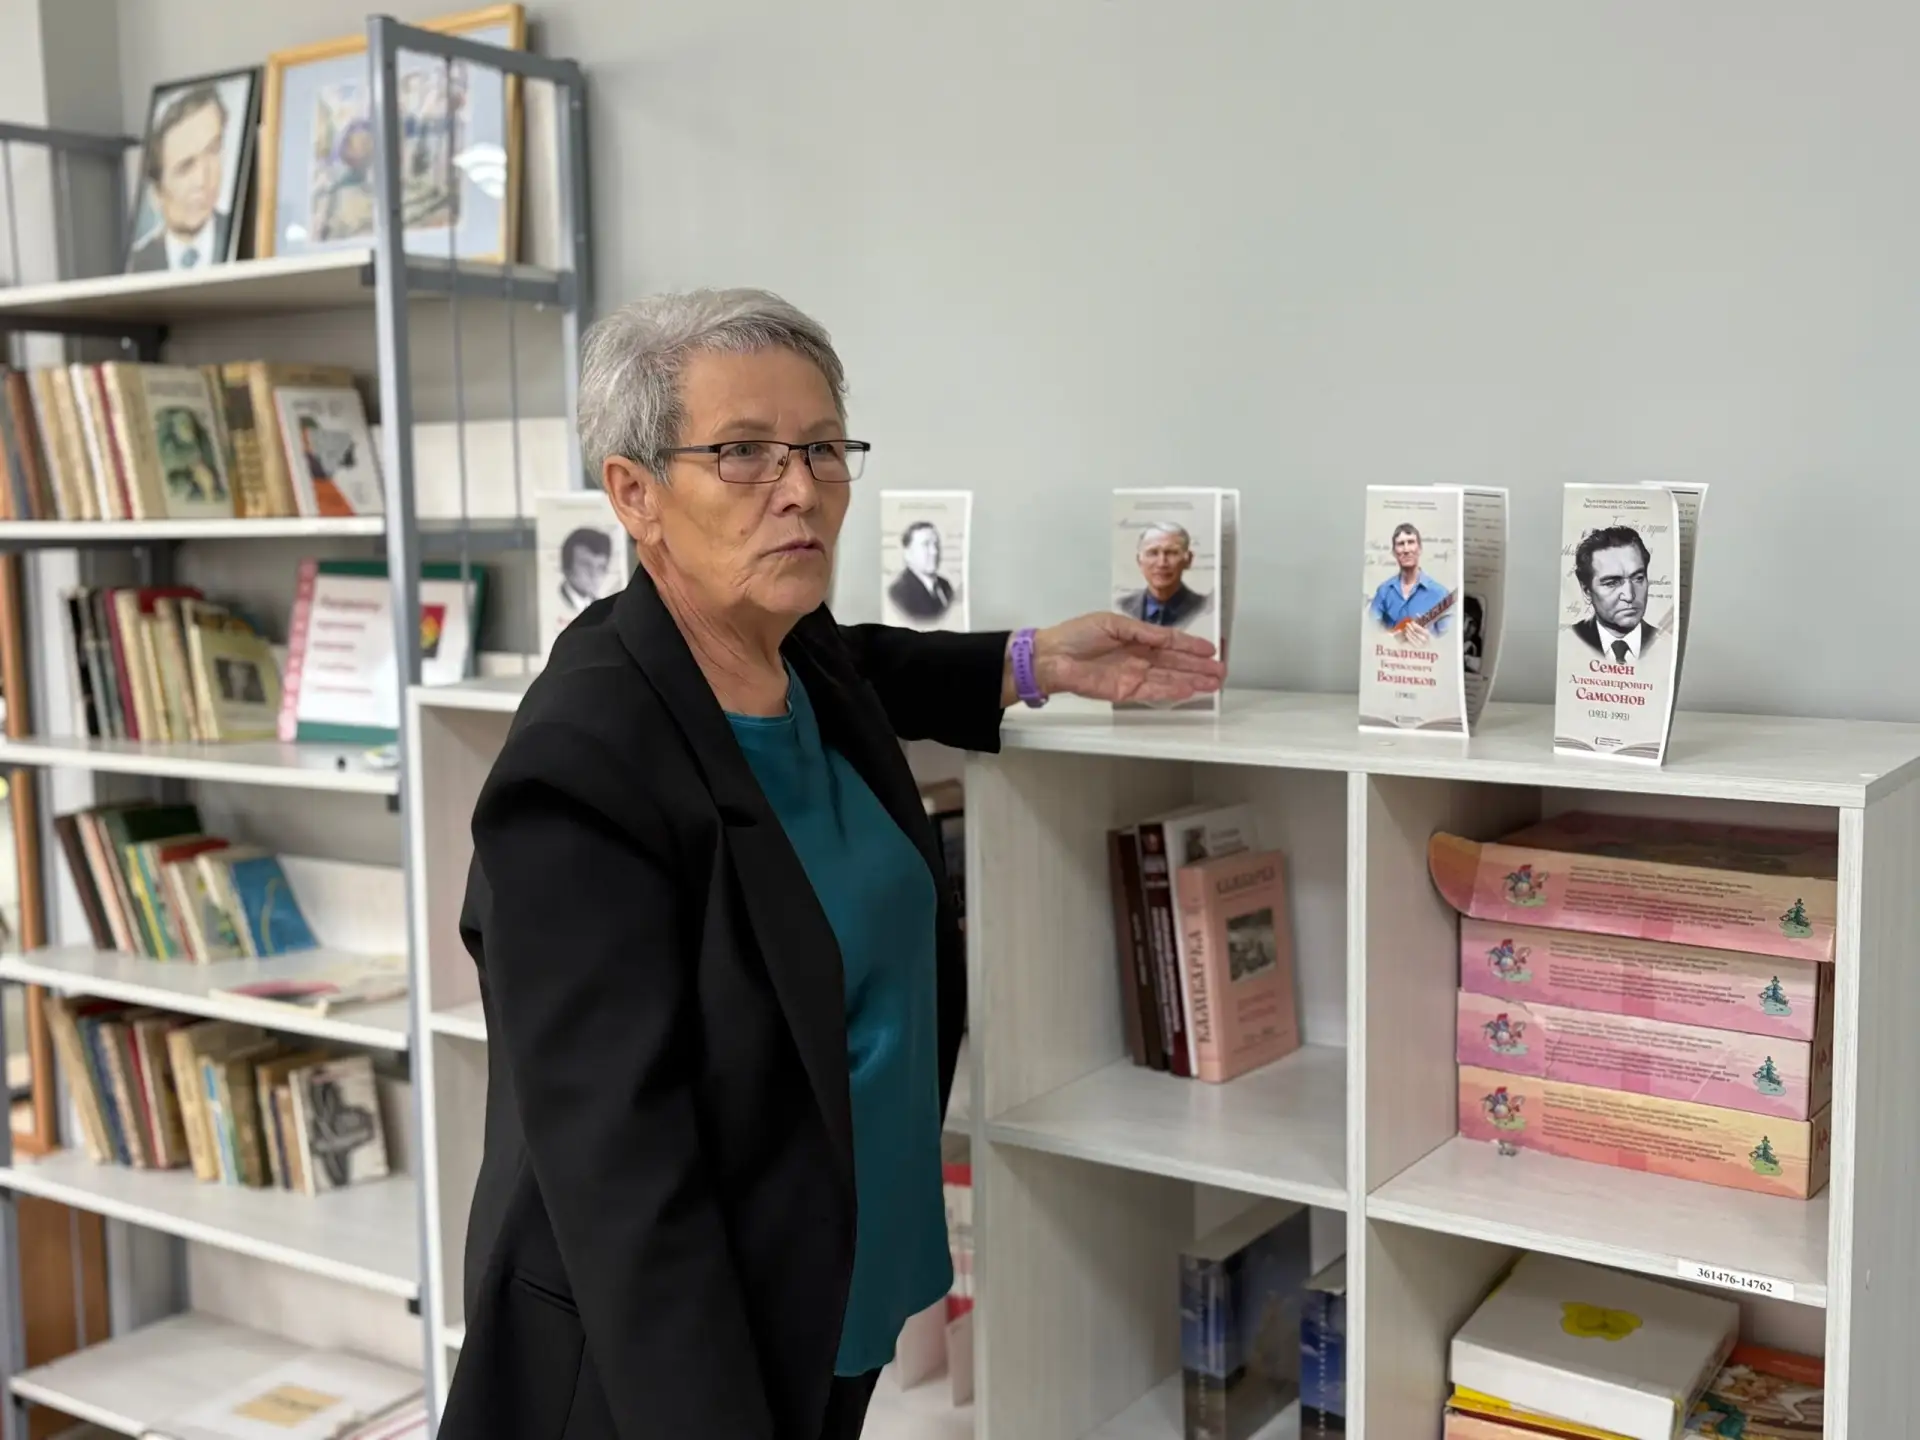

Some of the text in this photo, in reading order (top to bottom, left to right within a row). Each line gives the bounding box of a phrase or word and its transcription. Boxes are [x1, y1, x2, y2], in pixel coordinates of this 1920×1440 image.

[1375, 644, 1439, 663] Владимир
[1589, 659, 1635, 676] Семён
[1569, 674, 1654, 691] Александрович
[1575, 687, 1645, 706] Самсонов
[1697, 1267, 1774, 1293] 361476-14762
